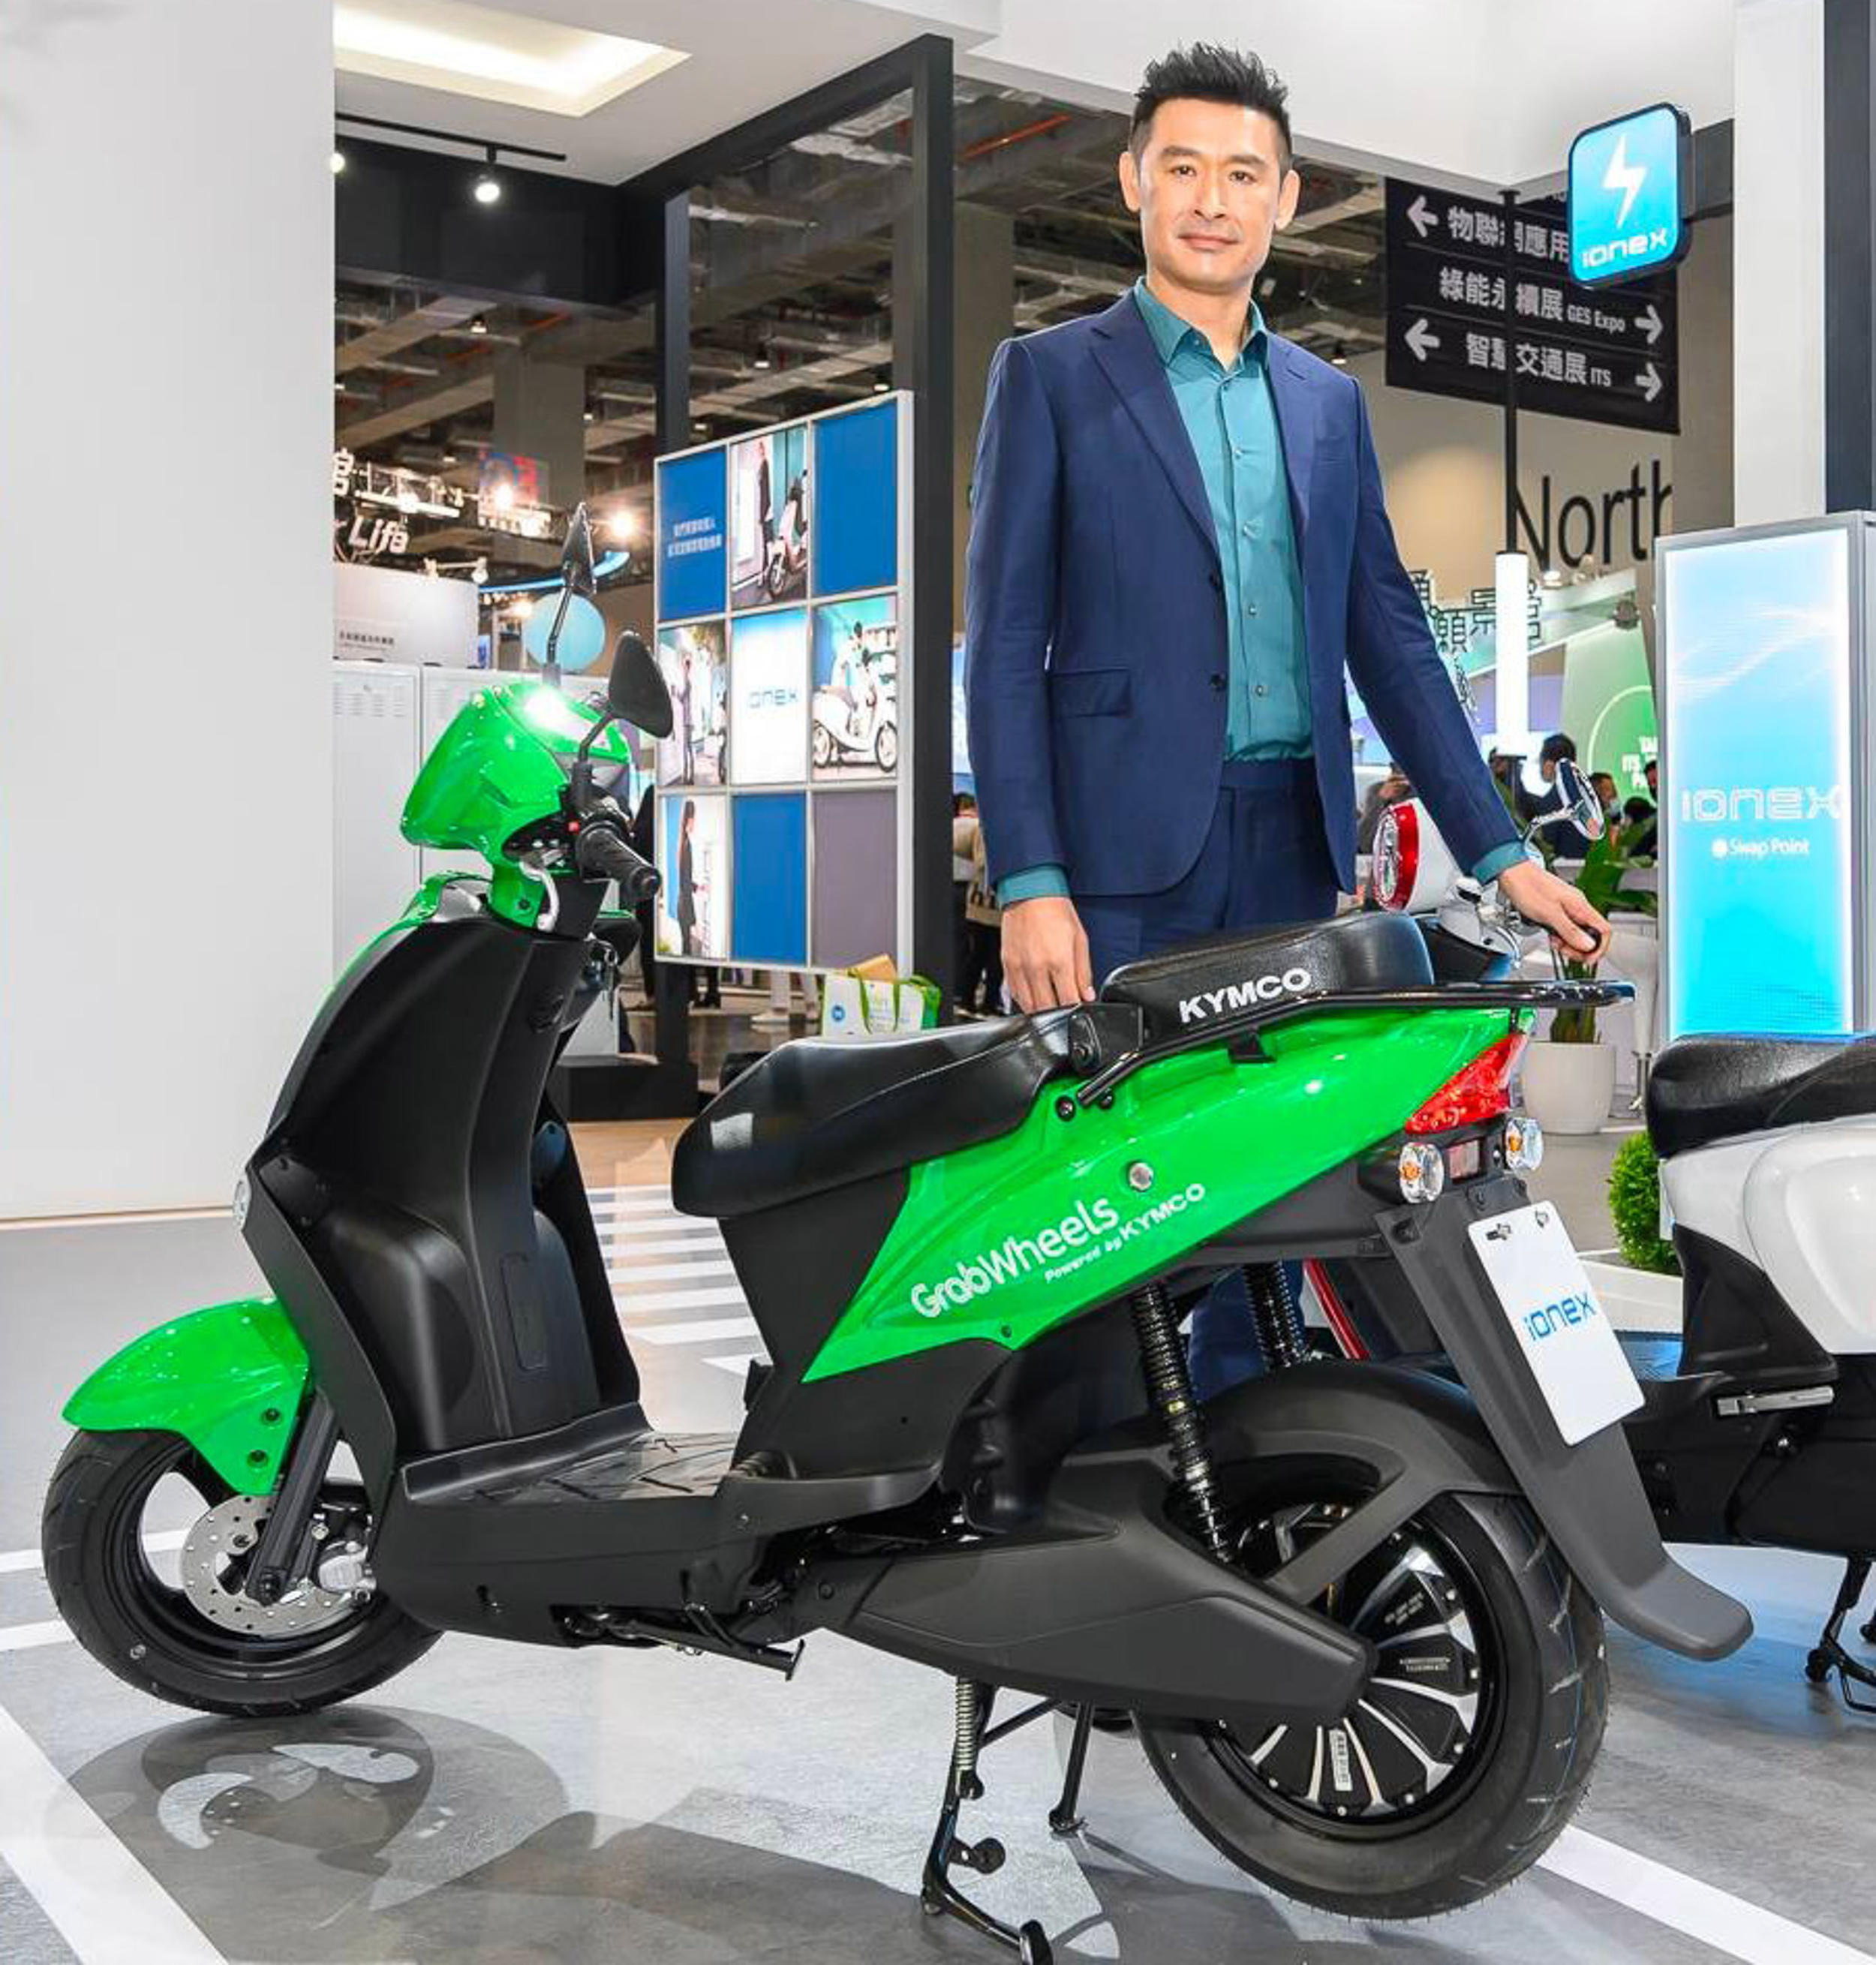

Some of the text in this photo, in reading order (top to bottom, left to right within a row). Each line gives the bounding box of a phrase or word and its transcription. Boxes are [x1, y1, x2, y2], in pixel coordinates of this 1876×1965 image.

[1582, 227, 1667, 269] ionex
[1567, 304, 1592, 326] GES
[1595, 310, 1625, 335] Expo
[1590, 367, 1611, 387] ITS
[349, 514, 408, 554] Life
[1681, 785, 1841, 822] ionex
[1771, 837, 1810, 855] Point
[1179, 967, 1312, 1023] KYMCO
[1044, 1182, 1205, 1283] Powered by KYMCO
[911, 1198, 1119, 1318] GrabWheels
[1523, 1291, 1597, 1342] ionex
